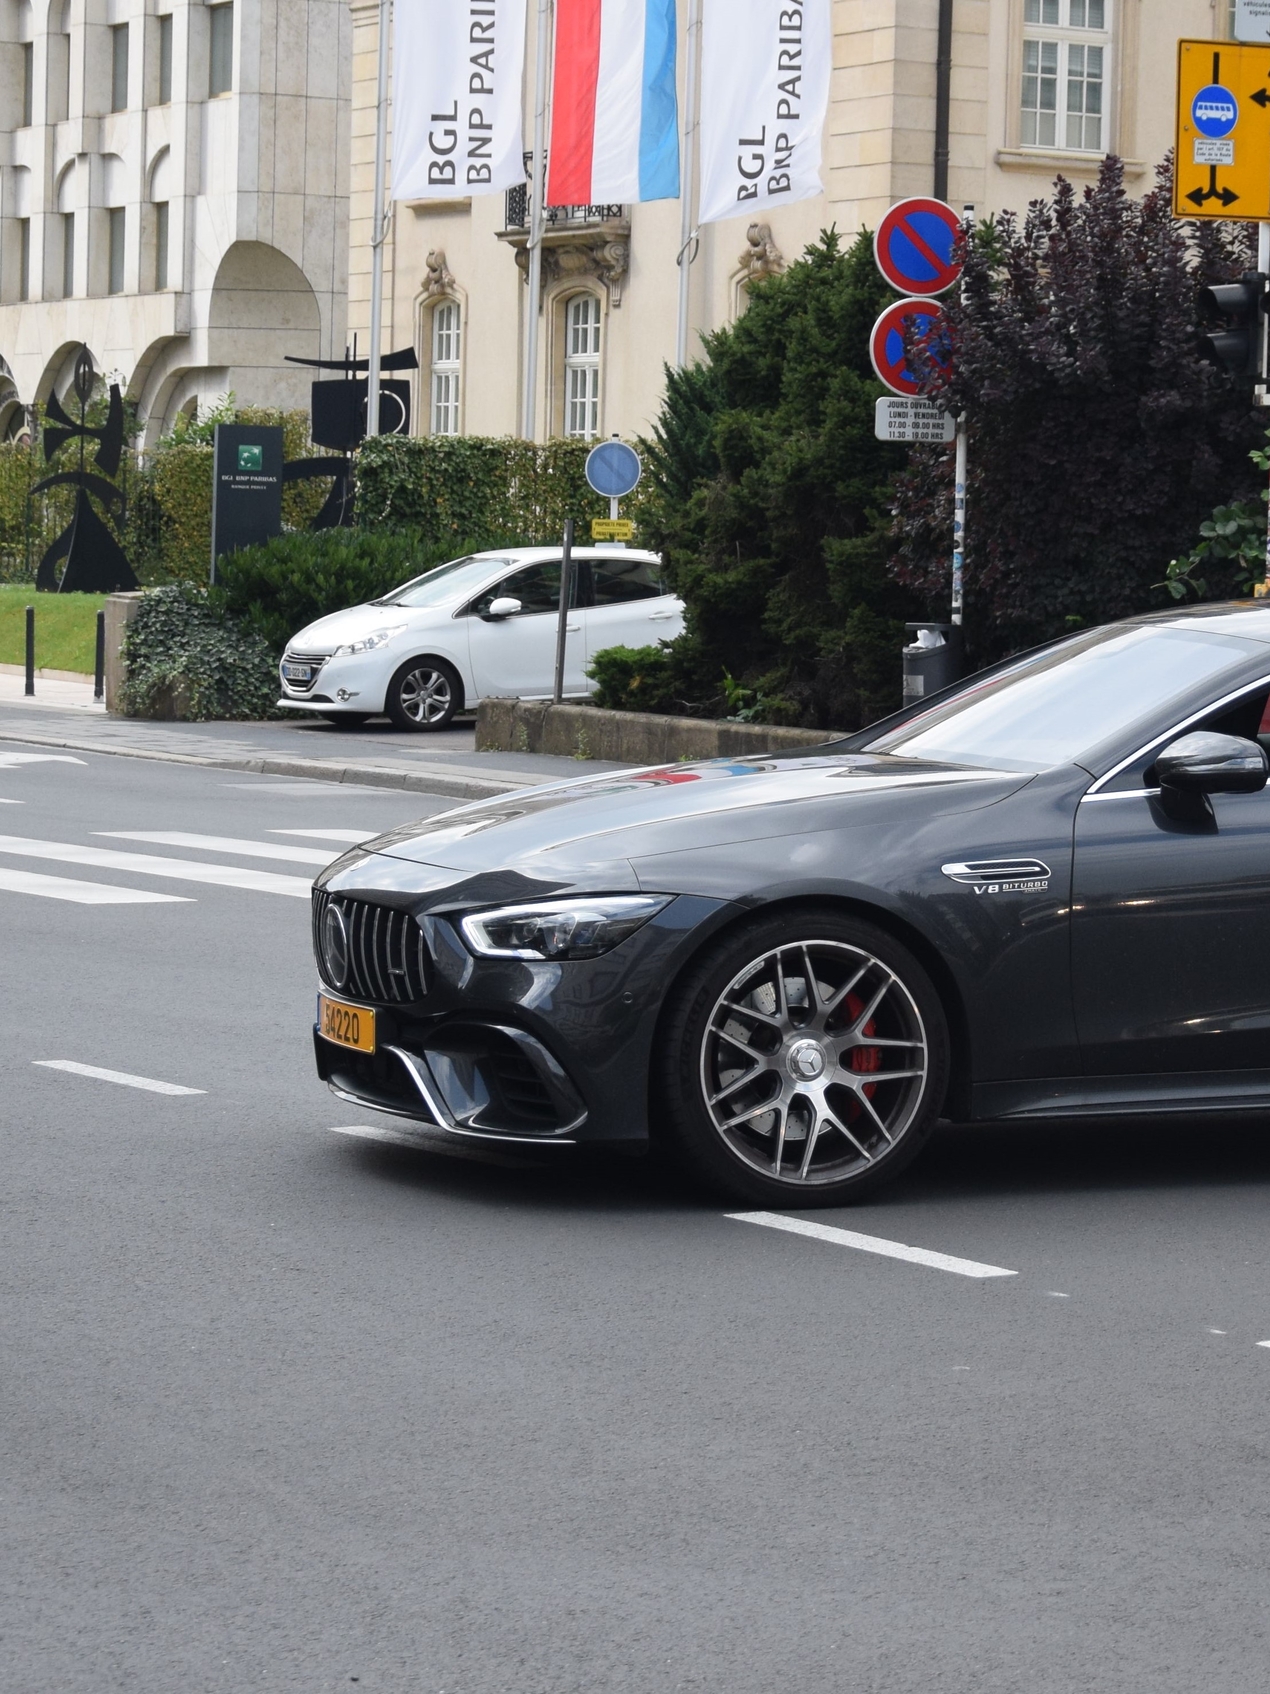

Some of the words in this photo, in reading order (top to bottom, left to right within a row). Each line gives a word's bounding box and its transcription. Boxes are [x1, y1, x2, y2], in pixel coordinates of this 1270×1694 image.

[469, 0, 496, 94] PARI
[428, 100, 458, 185] BGL
[467, 107, 493, 184] BNP
[887, 401, 908, 409] JOURS
[889, 411, 908, 419] LUNDI
[914, 412, 945, 420] VENDREDI
[973, 885, 999, 895] V8
[1002, 881, 1048, 890] BITURBO
